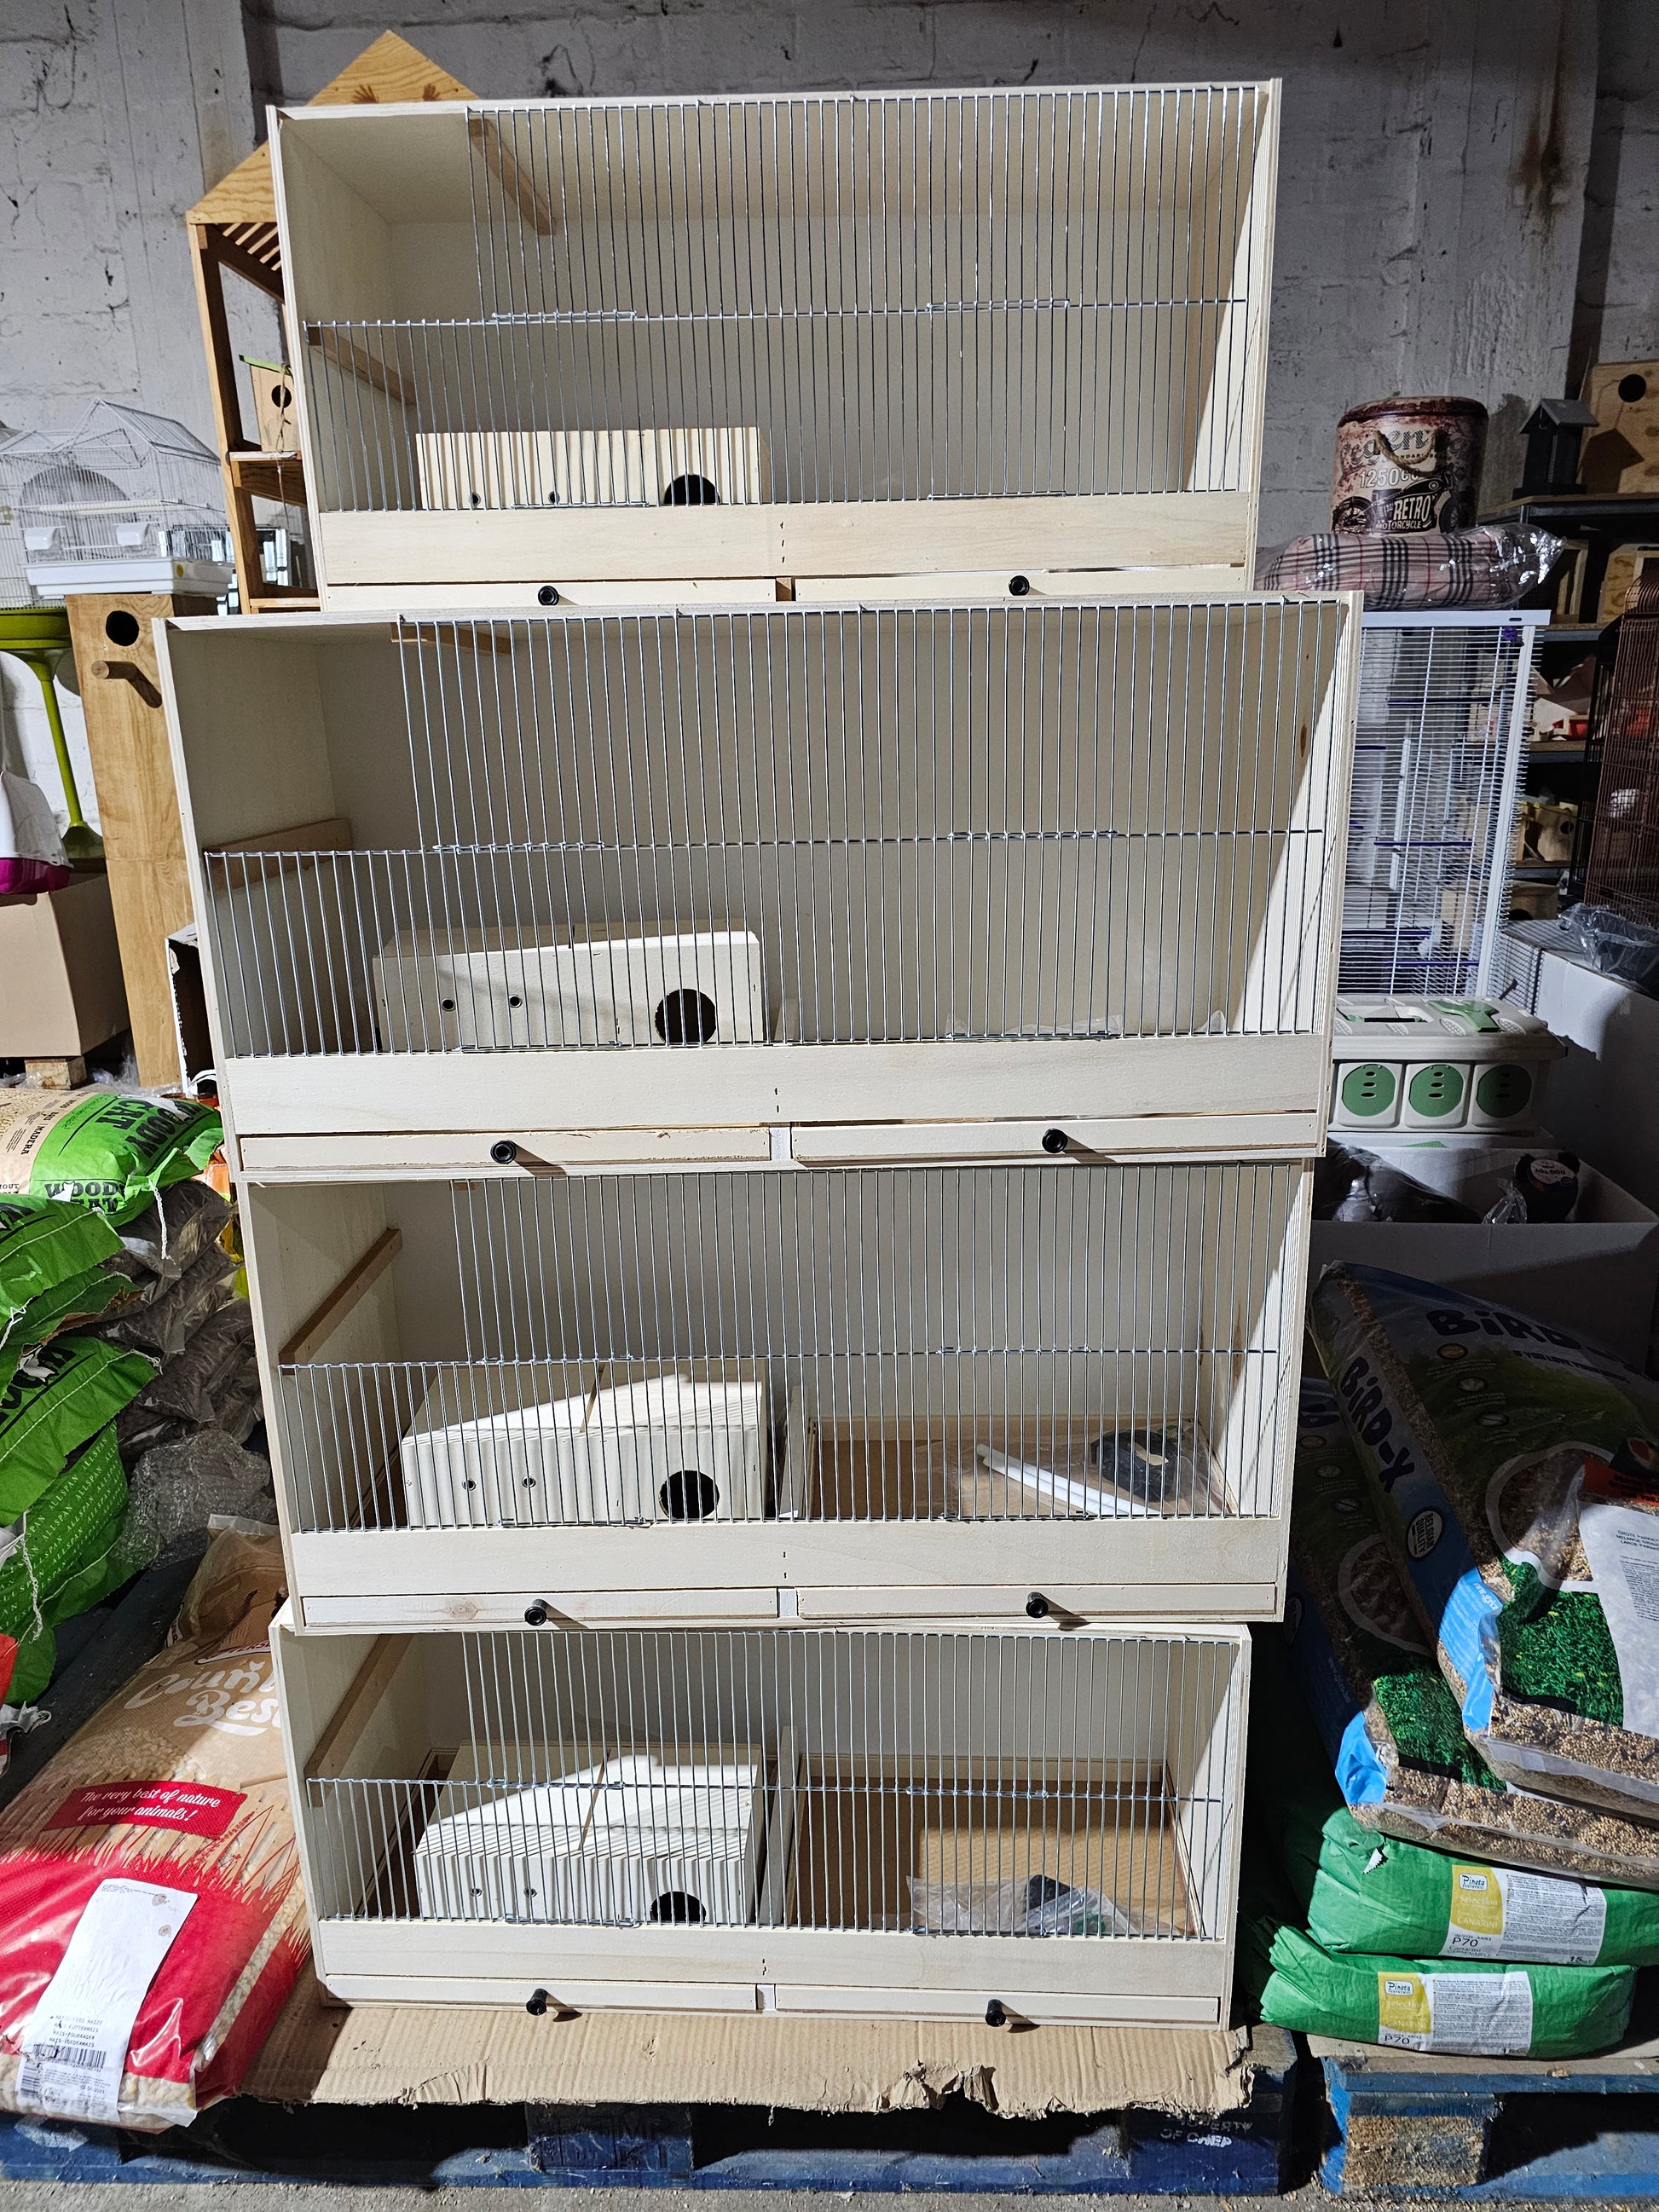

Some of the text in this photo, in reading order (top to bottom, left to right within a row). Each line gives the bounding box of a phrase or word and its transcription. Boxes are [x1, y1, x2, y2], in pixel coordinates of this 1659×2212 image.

[1393, 495, 1431, 522] RETRO
[1375, 520, 1421, 530] MOTORCYCLE
[95, 1100, 155, 1129] CAT
[20, 1126, 45, 1155] MADERA
[49, 1437, 107, 1510] ALLSPAN ALLSPAN
[42, 1505, 72, 1541] ALLSPAN
[75, 1466, 102, 1500] ALLSPAN
[1416, 1518, 1425, 1552] QUALITY
[1425, 1513, 1434, 1548] BELGIAN
[81, 1788, 221, 1808] The very best of nature
[77, 1805, 198, 1822] for your animals!
[1462, 1874, 1485, 1886] Pineta
[1459, 1895, 1498, 1906] Selection
[1457, 1916, 1499, 1927] CANARINI
[1452, 1937, 1478, 1948] P70
[1387, 1982, 1411, 1991] Pineta
[1384, 2035, 1410, 2044] P70
[1187, 2132, 1233, 2147] CHEP
